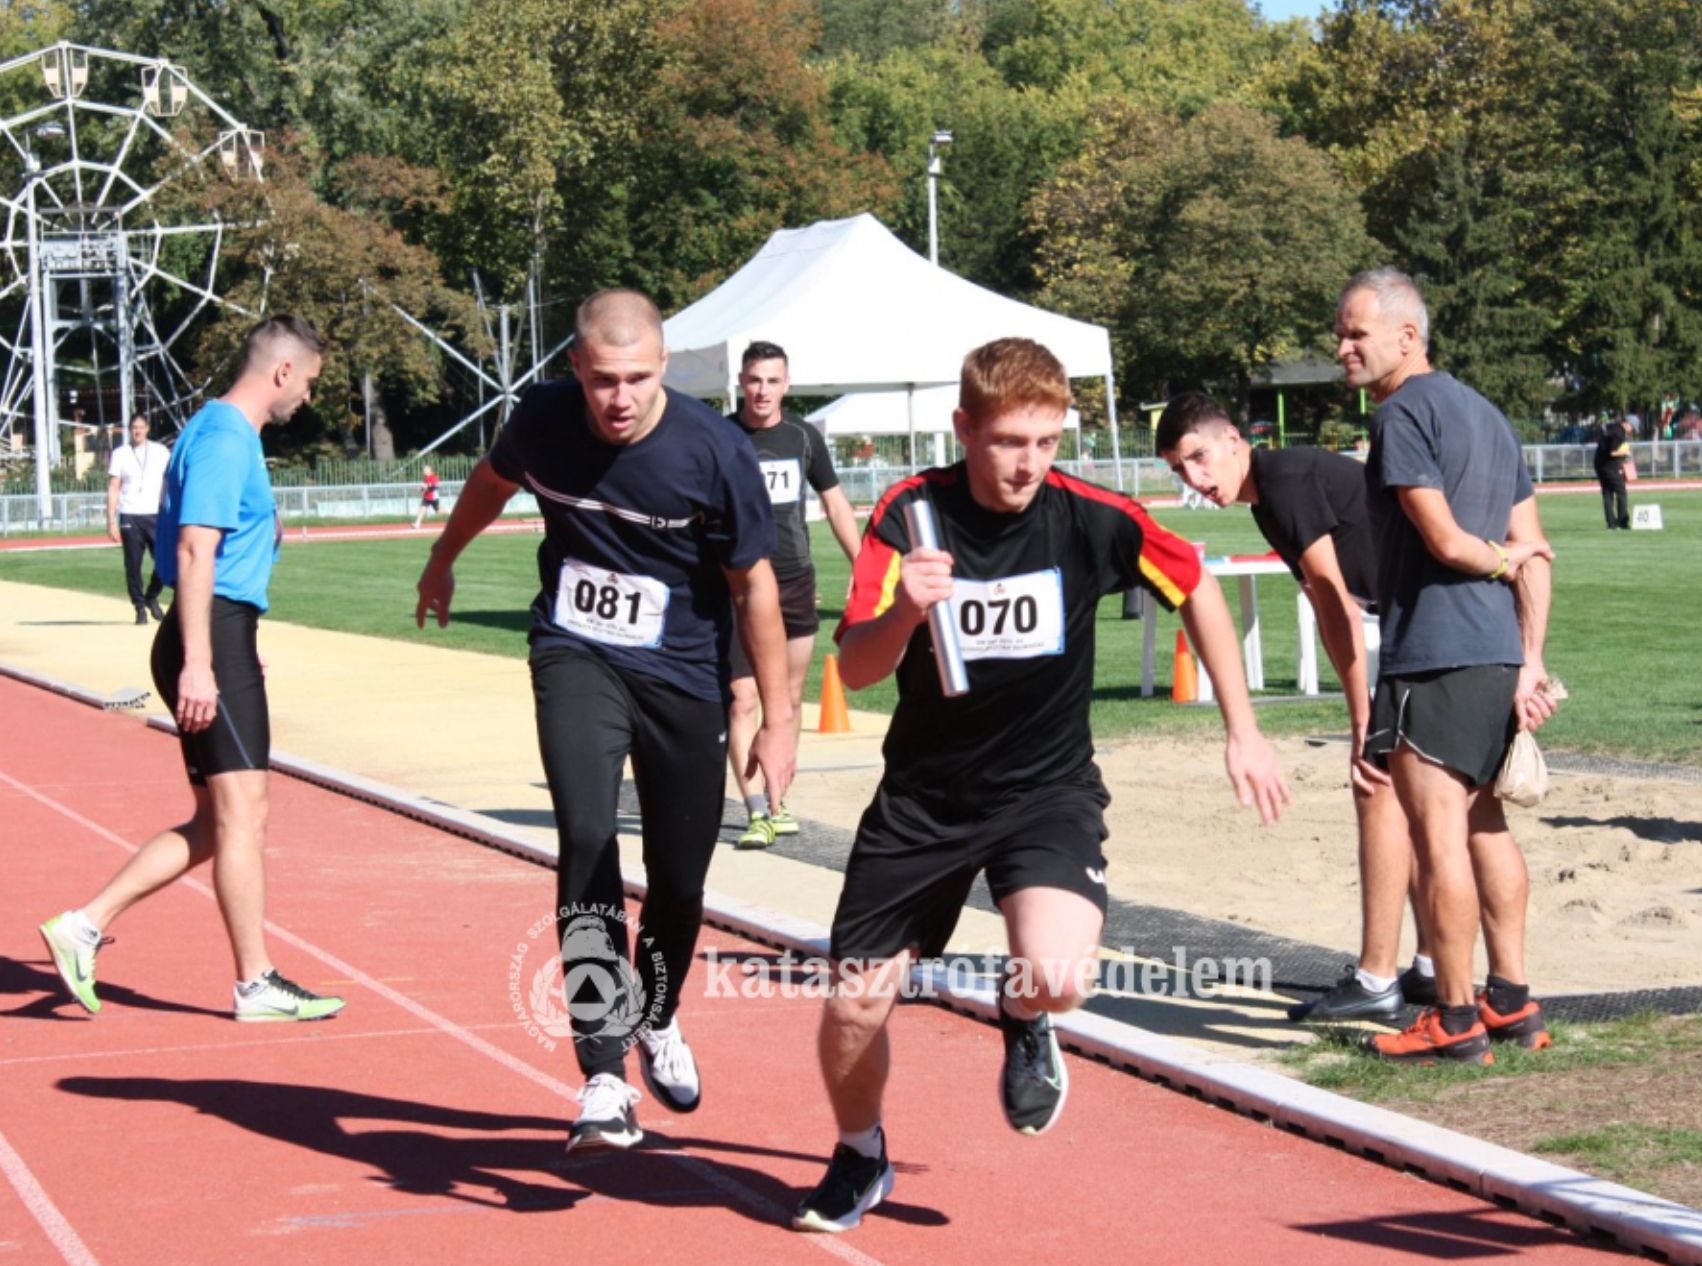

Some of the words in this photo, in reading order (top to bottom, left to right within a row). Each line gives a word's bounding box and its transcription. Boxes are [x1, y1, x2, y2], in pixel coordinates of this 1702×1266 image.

[764, 470, 789, 490] 71
[574, 578, 641, 625] 081
[960, 594, 1038, 636] 070
